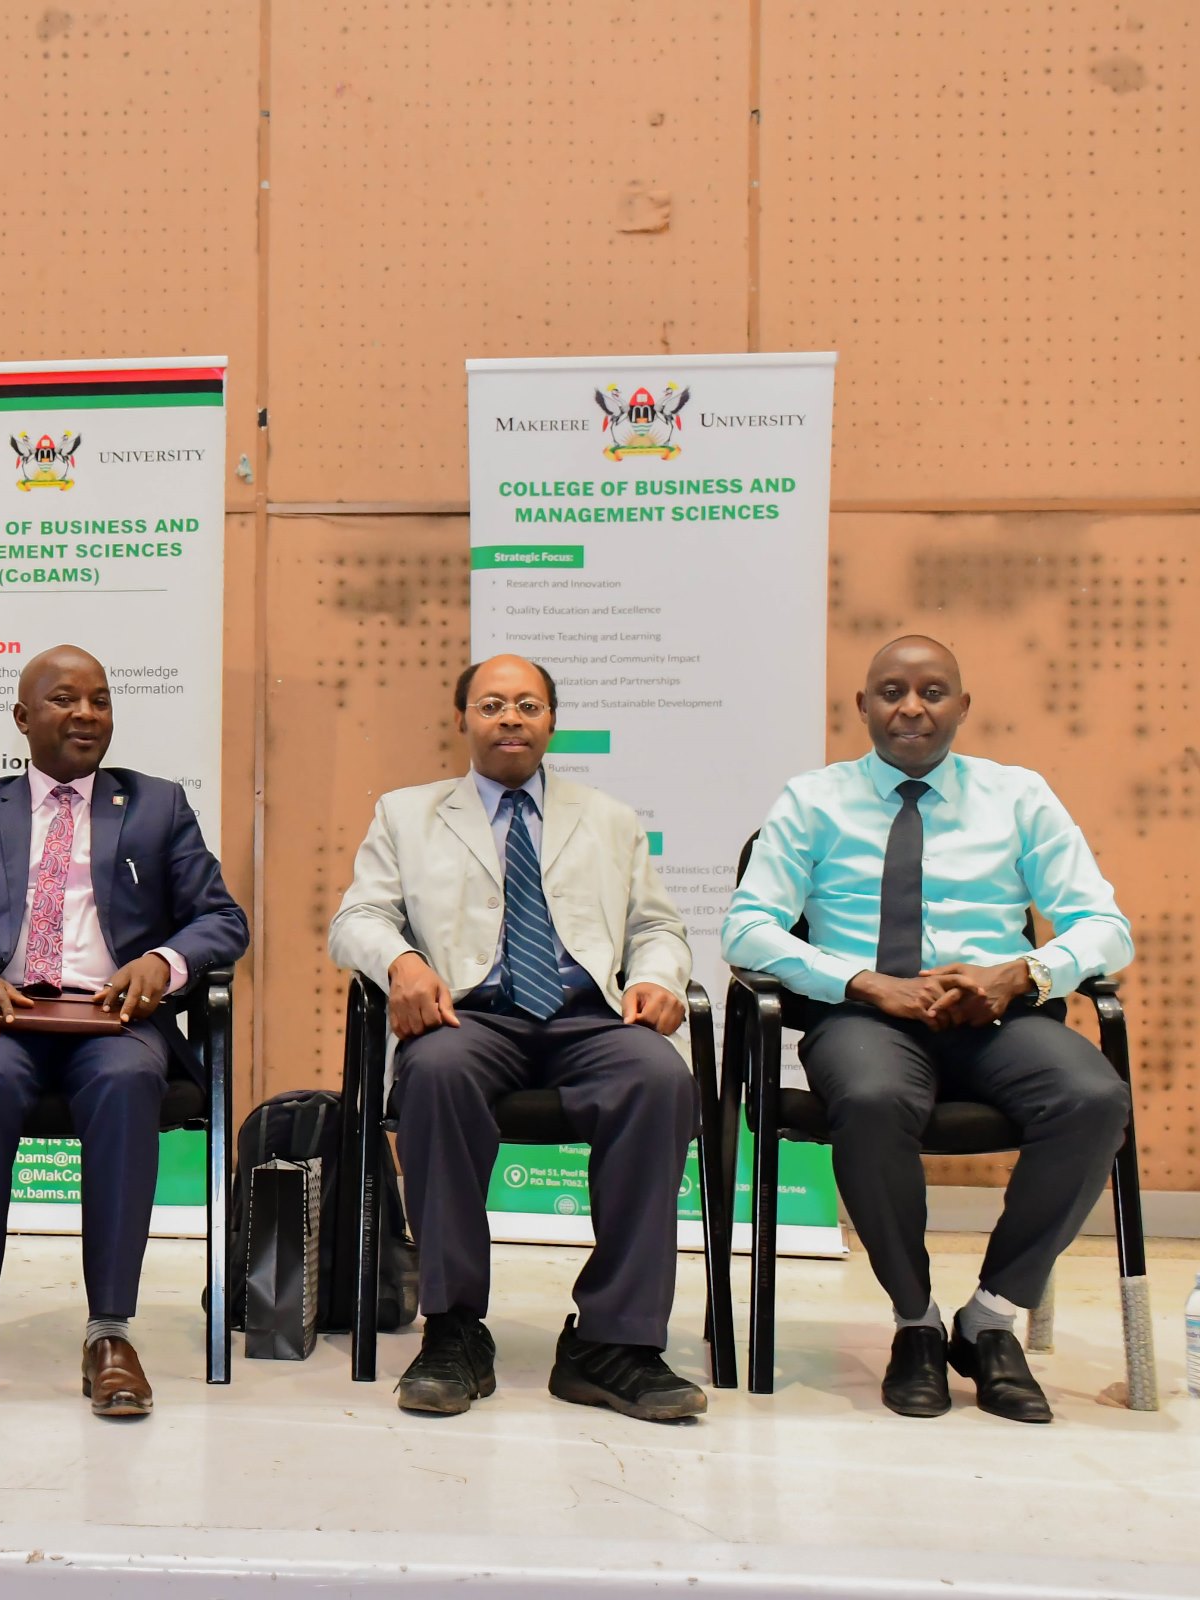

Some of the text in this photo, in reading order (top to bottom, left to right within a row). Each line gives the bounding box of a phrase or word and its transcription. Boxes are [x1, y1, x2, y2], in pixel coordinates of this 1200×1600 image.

[496, 413, 806, 431] MAKERERE UNIVERSITY
[99, 449, 205, 463] UNIVERSITY
[499, 478, 795, 496] COLLEGE OF BUSINESS AND
[516, 504, 779, 522] MANAGEMENT SCIENCES
[6, 521, 32, 535] OF
[41, 520, 147, 535] BUSINESS
[155, 519, 199, 533] AND
[76, 543, 182, 558] SCIENCES
[495, 552, 573, 563] Strategic Focus:
[507, 579, 621, 588] Research and Innovation
[506, 605, 661, 616] Quality Education and Excellence
[506, 632, 661, 643] Innovative Teaching and Learning
[590, 655, 607, 664] and
[609, 654, 665, 664] Community
[668, 654, 700, 664] Impact
[110, 666, 178, 679] knowledge
[600, 677, 617, 686] and
[620, 677, 680, 686] Partnerships
[110, 683, 183, 695] nsformation
[583, 699, 599, 708] and
[601, 699, 656, 708] Sustainable
[658, 698, 722, 709] Development
[665, 864, 710, 874] Statistics
[712, 865, 736, 875] (CPA
[690, 884, 702, 893] of
[16, 1151, 82, 1167] bams@m
[18, 1168, 82, 1184] @MakCo
